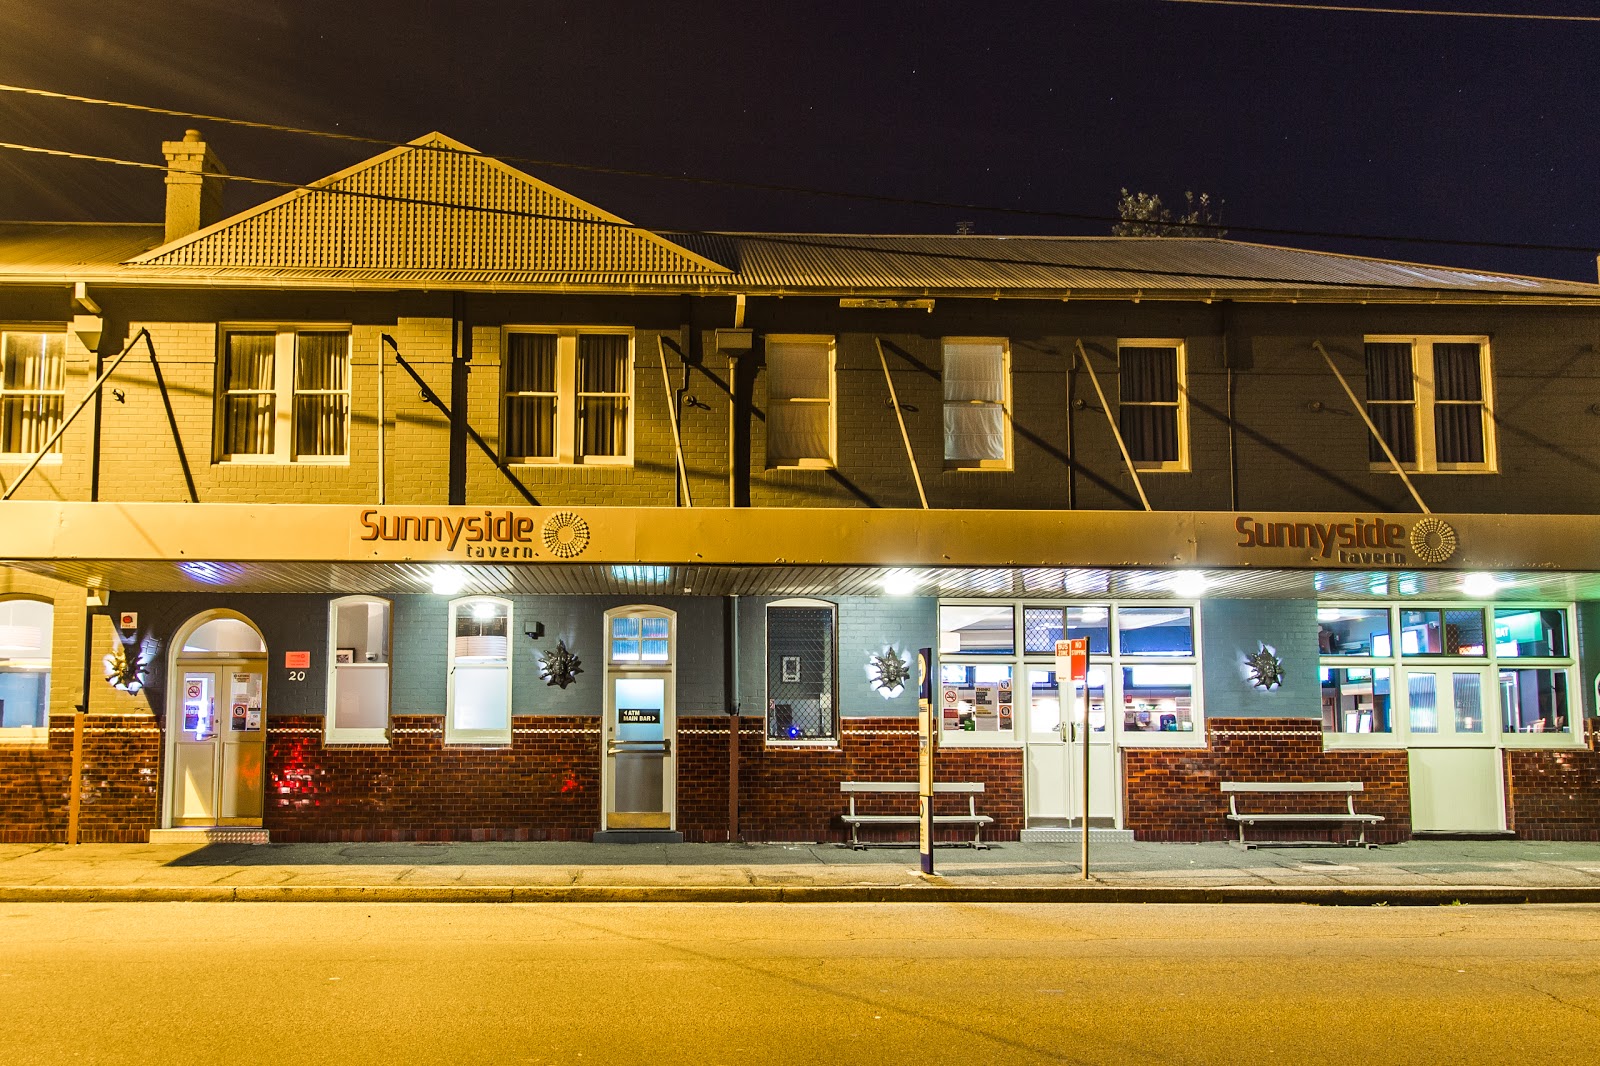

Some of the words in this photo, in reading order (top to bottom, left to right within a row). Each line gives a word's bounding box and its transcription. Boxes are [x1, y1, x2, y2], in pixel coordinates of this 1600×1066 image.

[360, 509, 534, 551] Sunnyside
[1234, 516, 1406, 557] Sunnyside
[466, 544, 533, 558] tavern
[1337, 549, 1406, 564] tavern
[1074, 641, 1082, 649] NO
[288, 670, 306, 681] 20
